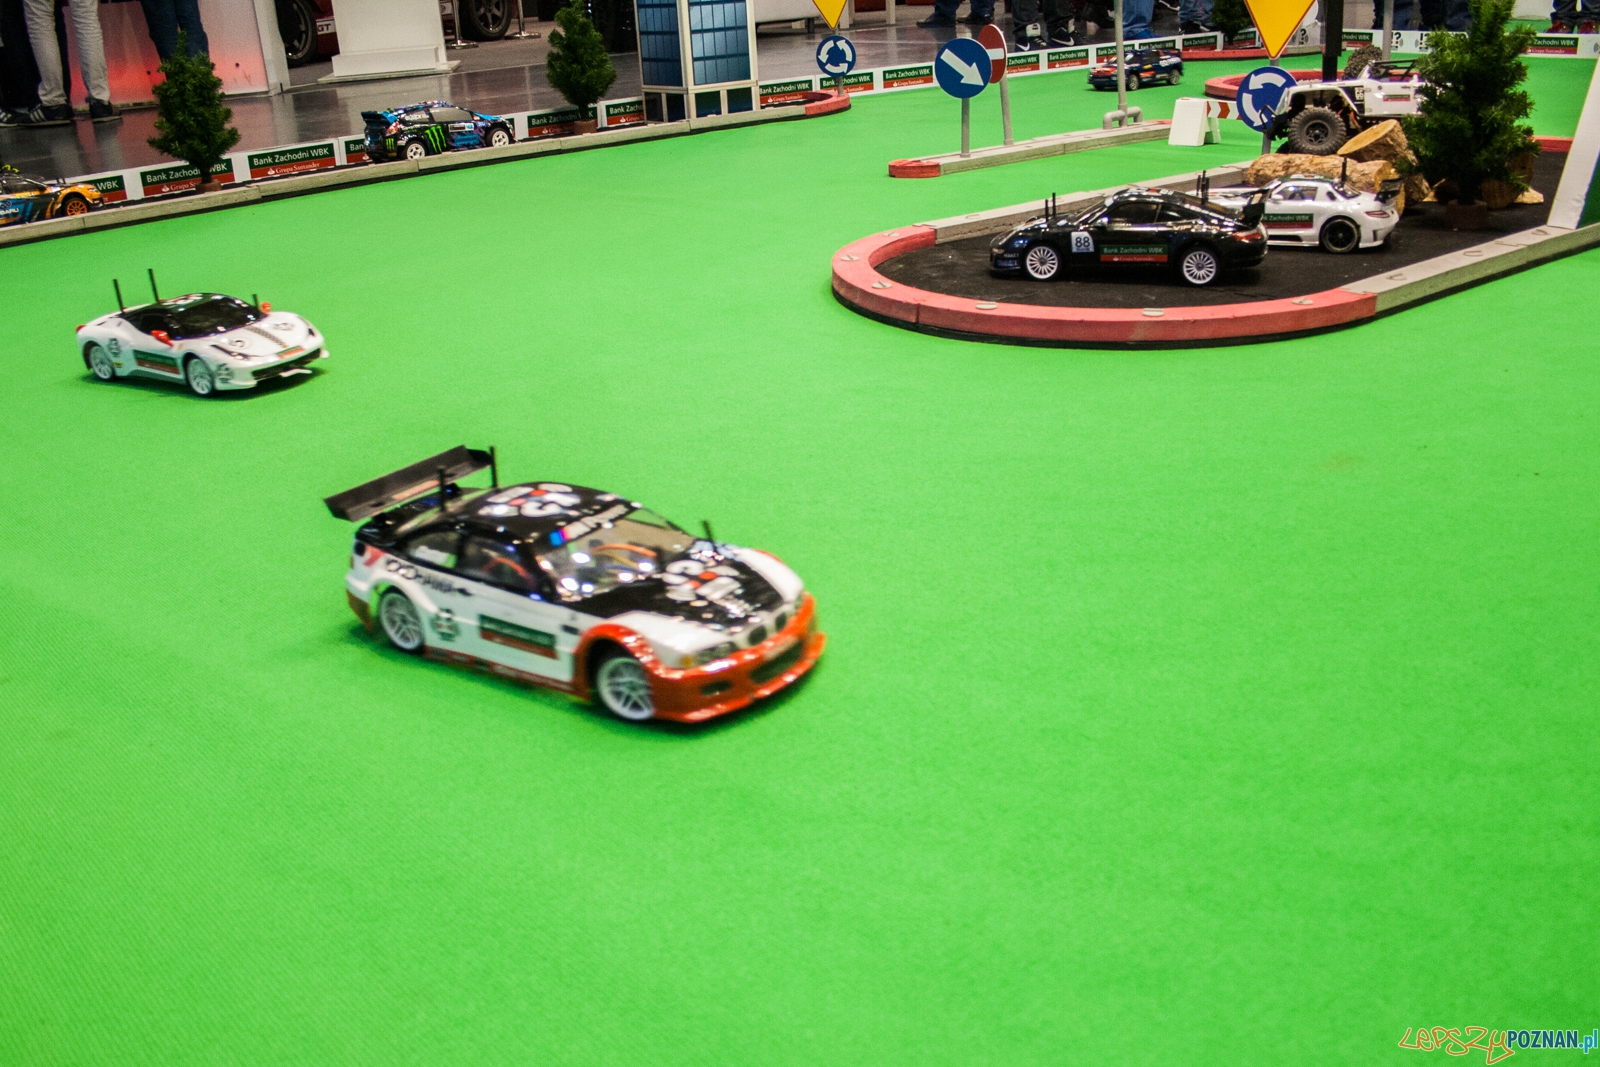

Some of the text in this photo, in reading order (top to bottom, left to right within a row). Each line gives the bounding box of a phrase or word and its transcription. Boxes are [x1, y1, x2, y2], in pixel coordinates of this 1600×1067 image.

[1060, 52, 1077, 60] Zachodni
[898, 70, 919, 78] Zachodni
[919, 68, 931, 76] WBK
[822, 79, 834, 87] Bank
[858, 75, 871, 83] WBK
[773, 84, 797, 93] Zachodni
[797, 82, 810, 90] WBK
[609, 103, 643, 115] Bank Zacho
[531, 116, 548, 126] Bank
[349, 143, 364, 152] Ban
[253, 147, 330, 166] Bank Zachodni WBK
[275, 161, 320, 175] Grupa Santander
[146, 171, 168, 183] Bank
[97, 180, 119, 191] WBK
[1075, 236, 1091, 248] 88
